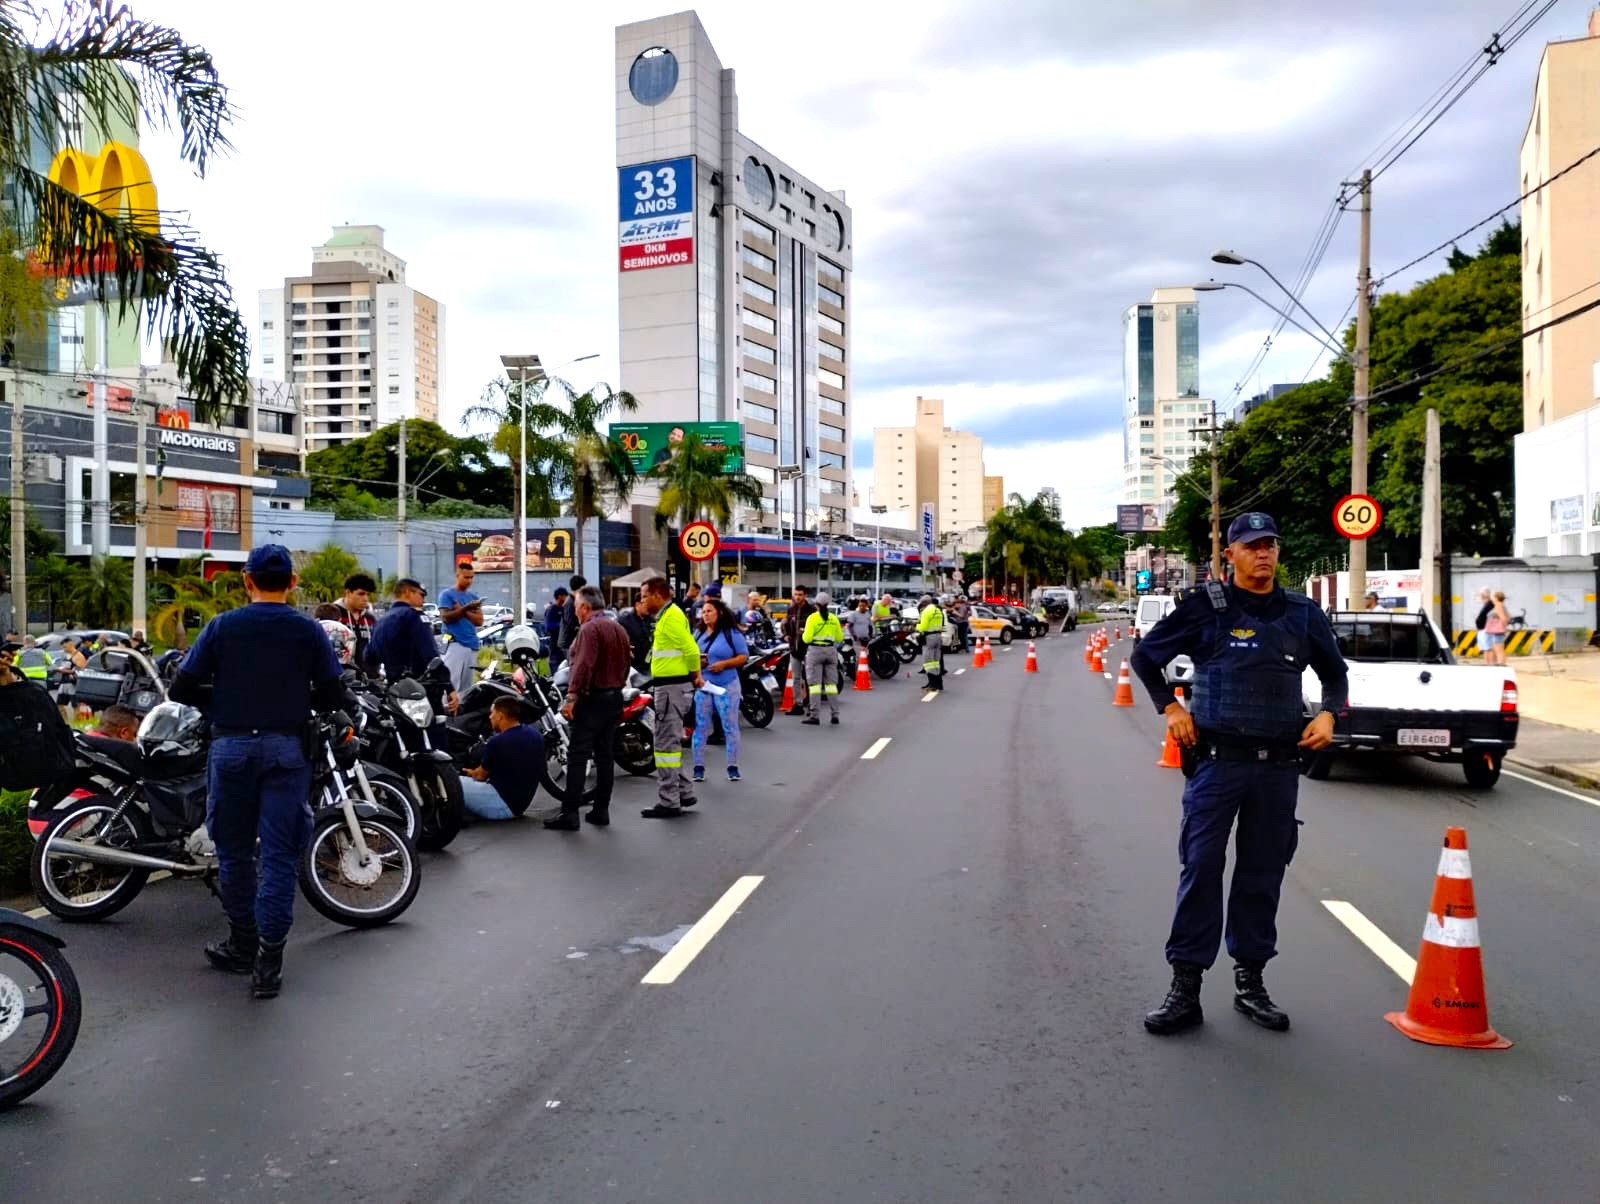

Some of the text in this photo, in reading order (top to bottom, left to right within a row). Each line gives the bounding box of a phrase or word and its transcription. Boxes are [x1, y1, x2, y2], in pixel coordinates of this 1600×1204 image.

[634, 167, 677, 200] 33
[634, 197, 677, 215] ANOS
[623, 252, 688, 269] SEMINOVOS
[161, 430, 236, 452] McDonald's
[1343, 505, 1371, 524] 60
[686, 531, 710, 548] 60
